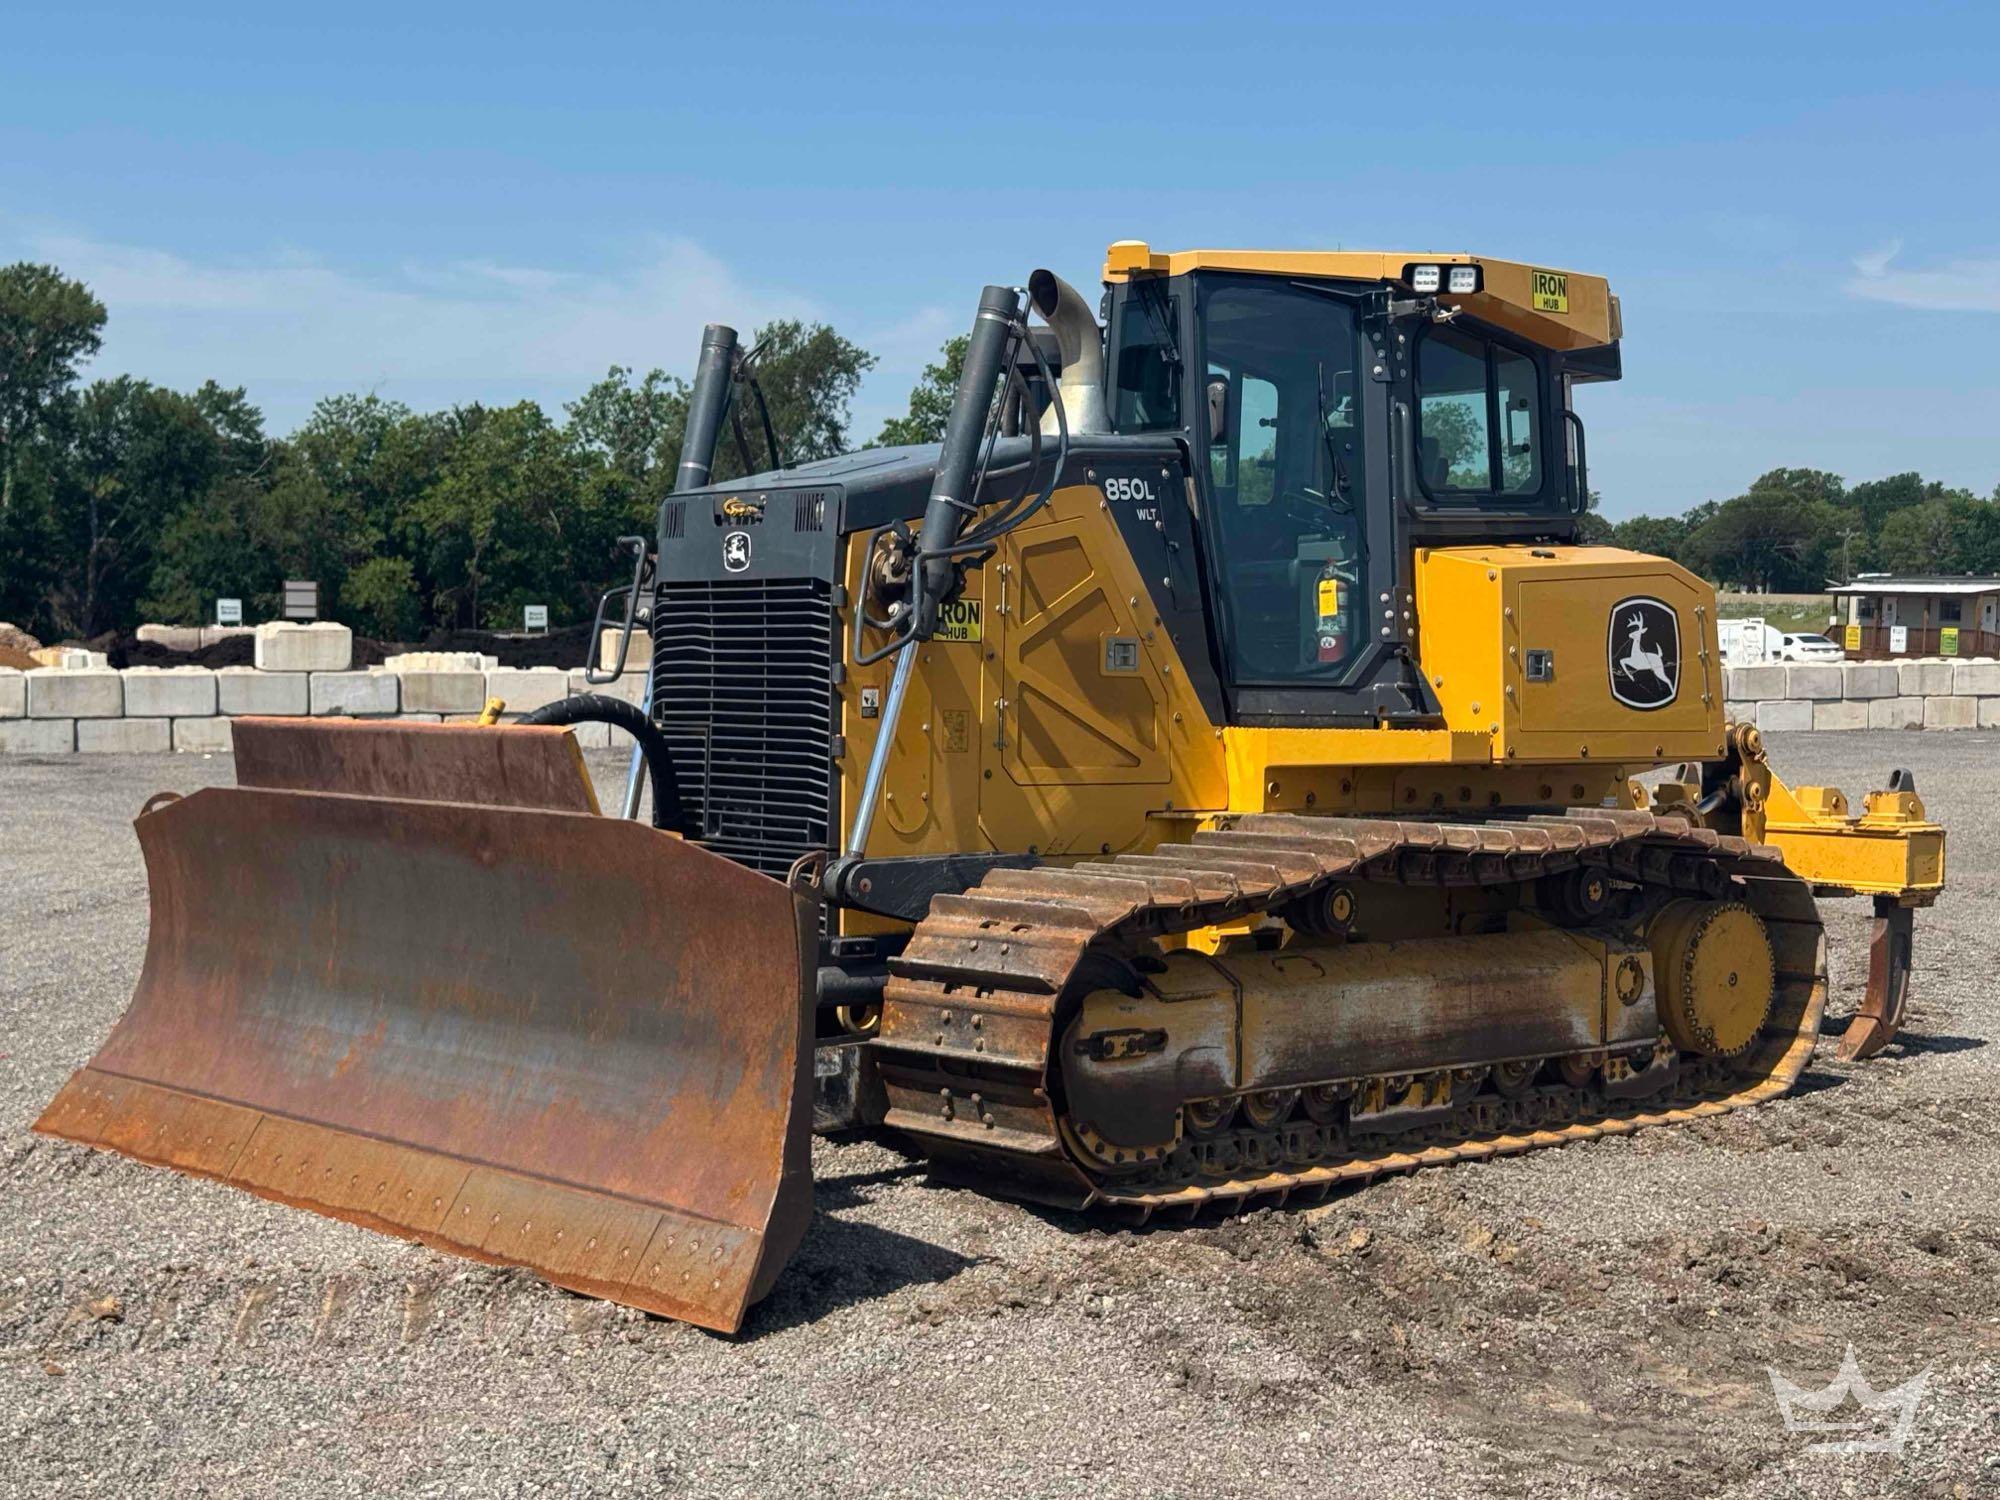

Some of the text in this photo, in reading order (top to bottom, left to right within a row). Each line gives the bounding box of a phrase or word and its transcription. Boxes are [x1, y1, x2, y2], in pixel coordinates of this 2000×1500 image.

[1534, 273, 1567, 298] IRON
[1543, 297, 1560, 310] HUB
[1104, 478, 1156, 501] 850L
[1136, 508, 1157, 521] WLT
